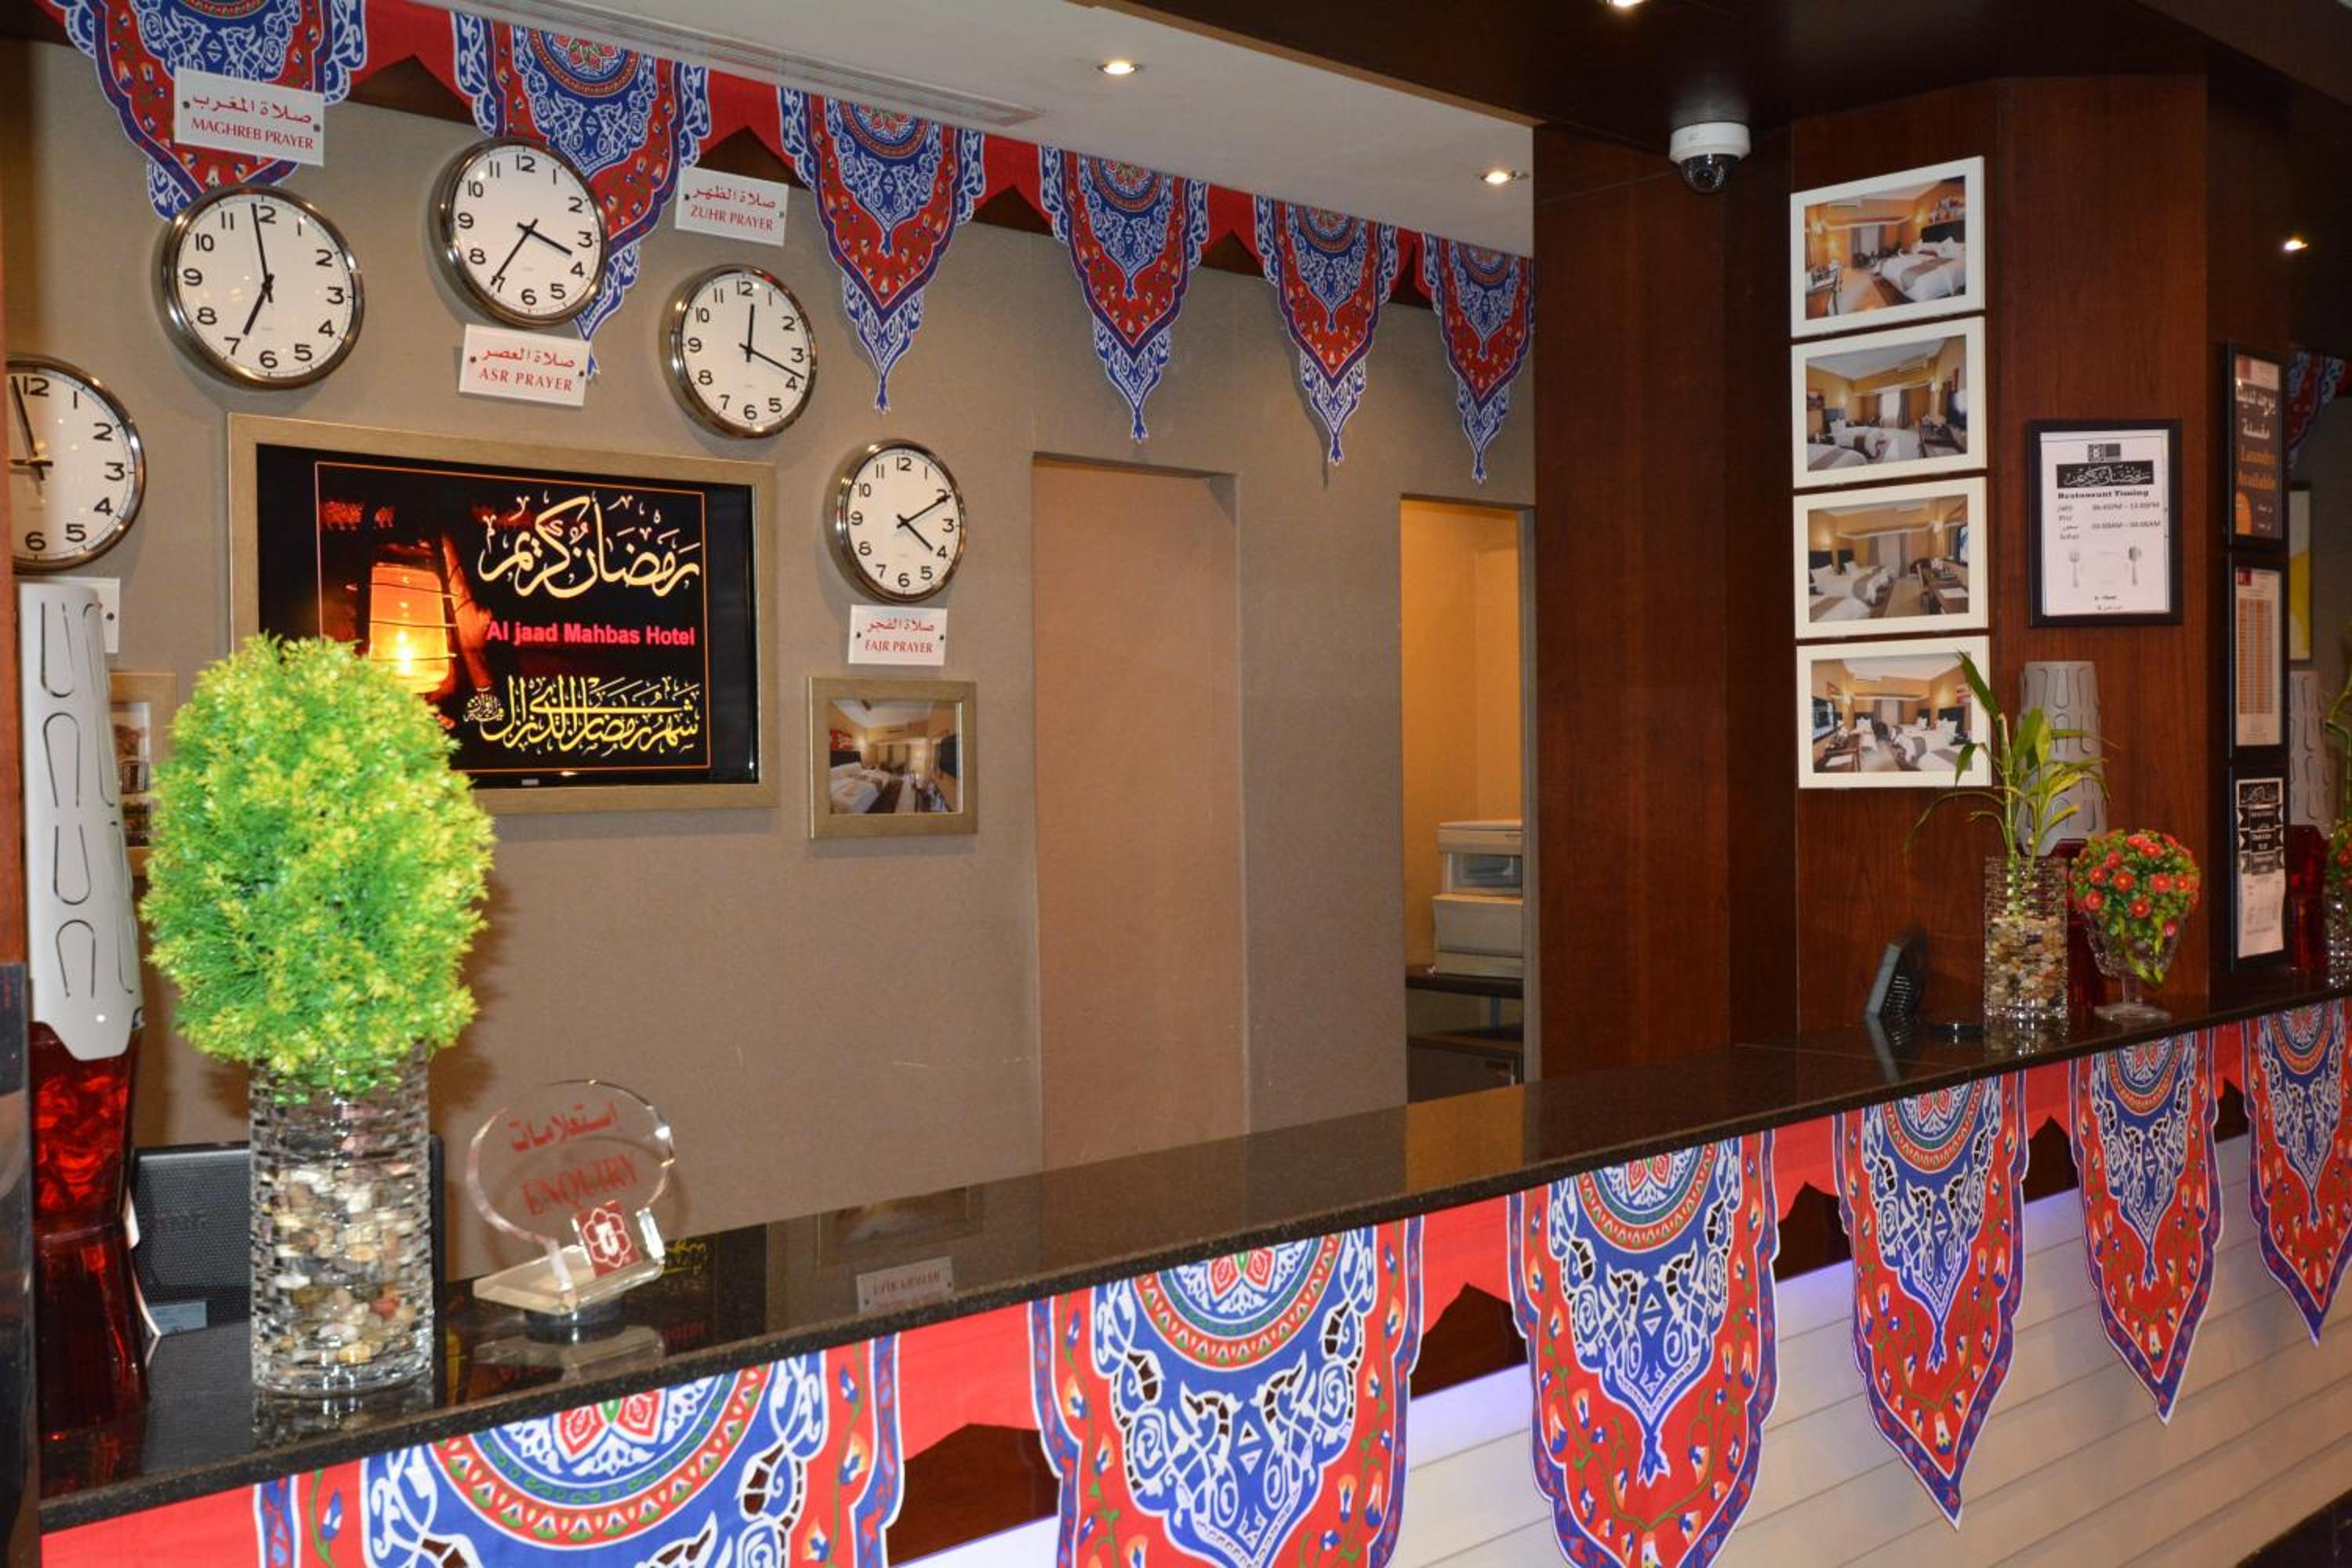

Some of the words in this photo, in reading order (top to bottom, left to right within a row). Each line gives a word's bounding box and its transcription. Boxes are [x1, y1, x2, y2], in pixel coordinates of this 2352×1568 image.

[193, 96, 255, 111] المغرب
[260, 100, 311, 122] صلاة
[191, 118, 262, 140] MAGHREB
[265, 129, 314, 149] PRAYER
[488, 160, 501, 179] 11
[515, 153, 535, 174] 12
[553, 167, 558, 185] 1
[467, 179, 485, 198] 10
[691, 184, 736, 200] الظهر
[568, 196, 585, 214] 2
[739, 191, 776, 208] صلاة
[220, 210, 235, 230] 11
[457, 212, 474, 230] 9
[691, 204, 725, 221] ZUHR
[730, 212, 773, 230] PRAYER
[297, 217, 303, 237] 1
[194, 233, 215, 254] 10
[577, 230, 593, 249] 3
[314, 249, 334, 268] 2
[468, 248, 487, 266] 8
[182, 267, 203, 288] 9
[570, 261, 586, 279] 4
[492, 275, 506, 293] 7
[550, 282, 566, 300] 5
[735, 279, 753, 297] 12
[326, 286, 345, 307] 3
[521, 288, 538, 307] 6
[713, 287, 724, 304] 11
[768, 290, 773, 307] 1
[196, 306, 218, 326] 8
[695, 307, 710, 325] 10
[782, 315, 796, 332] 2
[318, 319, 335, 339] 4
[223, 337, 241, 356] 7
[294, 343, 314, 364] 5
[481, 347, 530, 360] العصر
[687, 337, 703, 354] 9
[259, 350, 278, 370] 6
[534, 350, 575, 367] صلاة
[790, 347, 804, 364] 3
[23, 376, 49, 397] 12
[480, 368, 509, 383] ASR
[515, 372, 572, 391] PRAYER
[698, 369, 714, 387] 8
[785, 376, 798, 391] 4
[73, 390, 79, 410] 1
[719, 394, 731, 411] 7
[768, 397, 782, 414] 5
[743, 404, 758, 421] 6
[92, 421, 114, 442] 2
[103, 461, 125, 481] 3
[874, 463, 886, 480] 11
[895, 455, 913, 472] 12
[924, 466, 929, 480] 1
[858, 481, 872, 499] 10
[93, 495, 114, 517] 4
[850, 510, 864, 526] 9
[941, 517, 955, 534] 3
[64, 521, 87, 543] 5
[24, 531, 47, 552] 6
[477, 491, 591, 598] كريم
[544, 492, 701, 598] رمضان
[858, 540, 873, 557] 8
[935, 545, 949, 560] 4
[874, 564, 887, 580] 7
[897, 572, 911, 588] 6
[920, 565, 935, 582] 5
[486, 621, 509, 641] Al
[514, 622, 559, 645] jaad
[564, 623, 641, 644] Mahbas
[646, 626, 695, 645] Hotel
[866, 617, 902, 633] الفجر
[865, 640, 890, 653] FAJR
[893, 641, 932, 653] PRAYER
[508, 1102, 618, 1153] استعلامات
[521, 1154, 639, 1216] ENQUIRY
